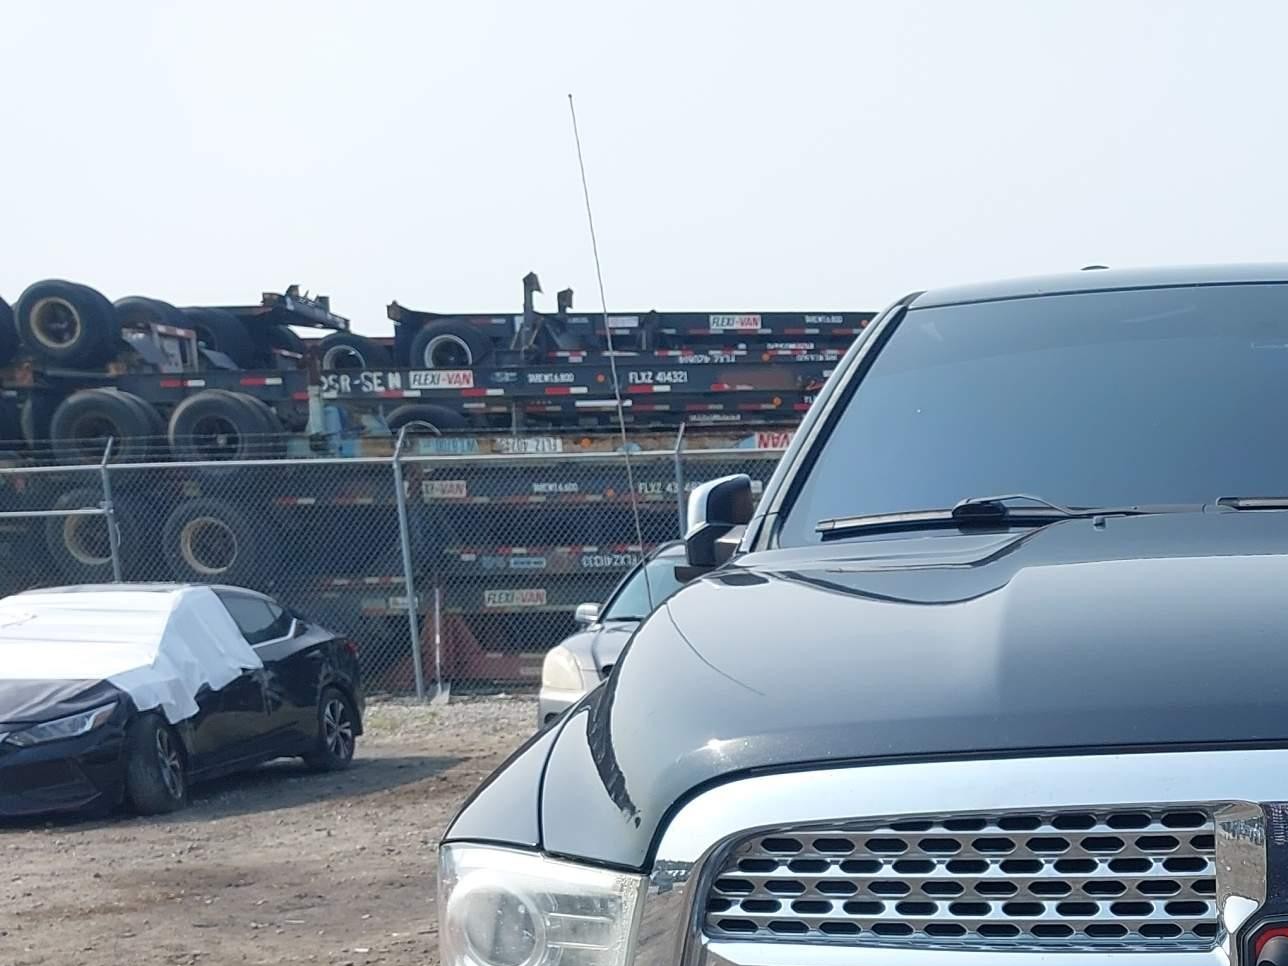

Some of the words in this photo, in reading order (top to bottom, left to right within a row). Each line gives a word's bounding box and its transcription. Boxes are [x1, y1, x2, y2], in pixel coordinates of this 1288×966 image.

[712, 316, 760, 328] FLEXI-VAN
[412, 371, 472, 386] FLEXI-VAN
[628, 371, 653, 383] FLXZ
[487, 590, 545, 604] FLEXI-VAN
